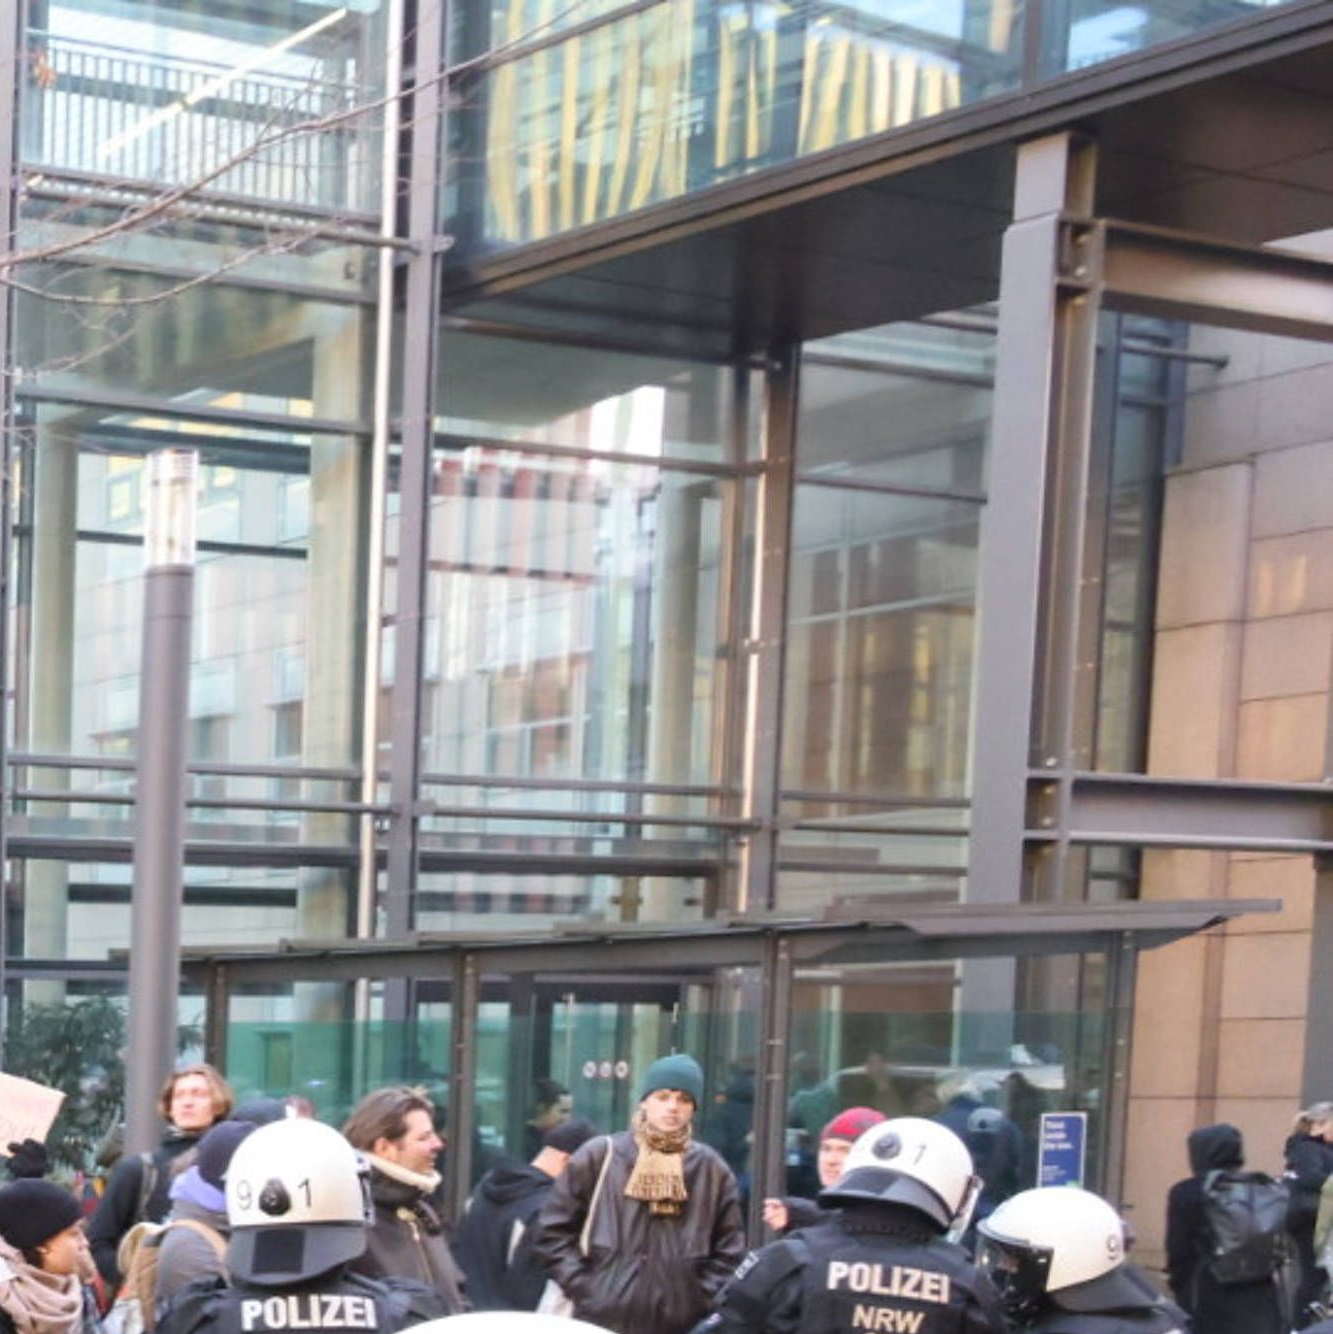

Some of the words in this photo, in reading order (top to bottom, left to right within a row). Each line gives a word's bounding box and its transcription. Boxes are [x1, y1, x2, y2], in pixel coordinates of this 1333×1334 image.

[236, 1179, 253, 1211] 9
[297, 1177, 312, 1208] 1
[826, 1260, 951, 1305] POLIZEI
[240, 1294, 378, 1331] POLIZEI
[852, 1303, 925, 1334] NRW
